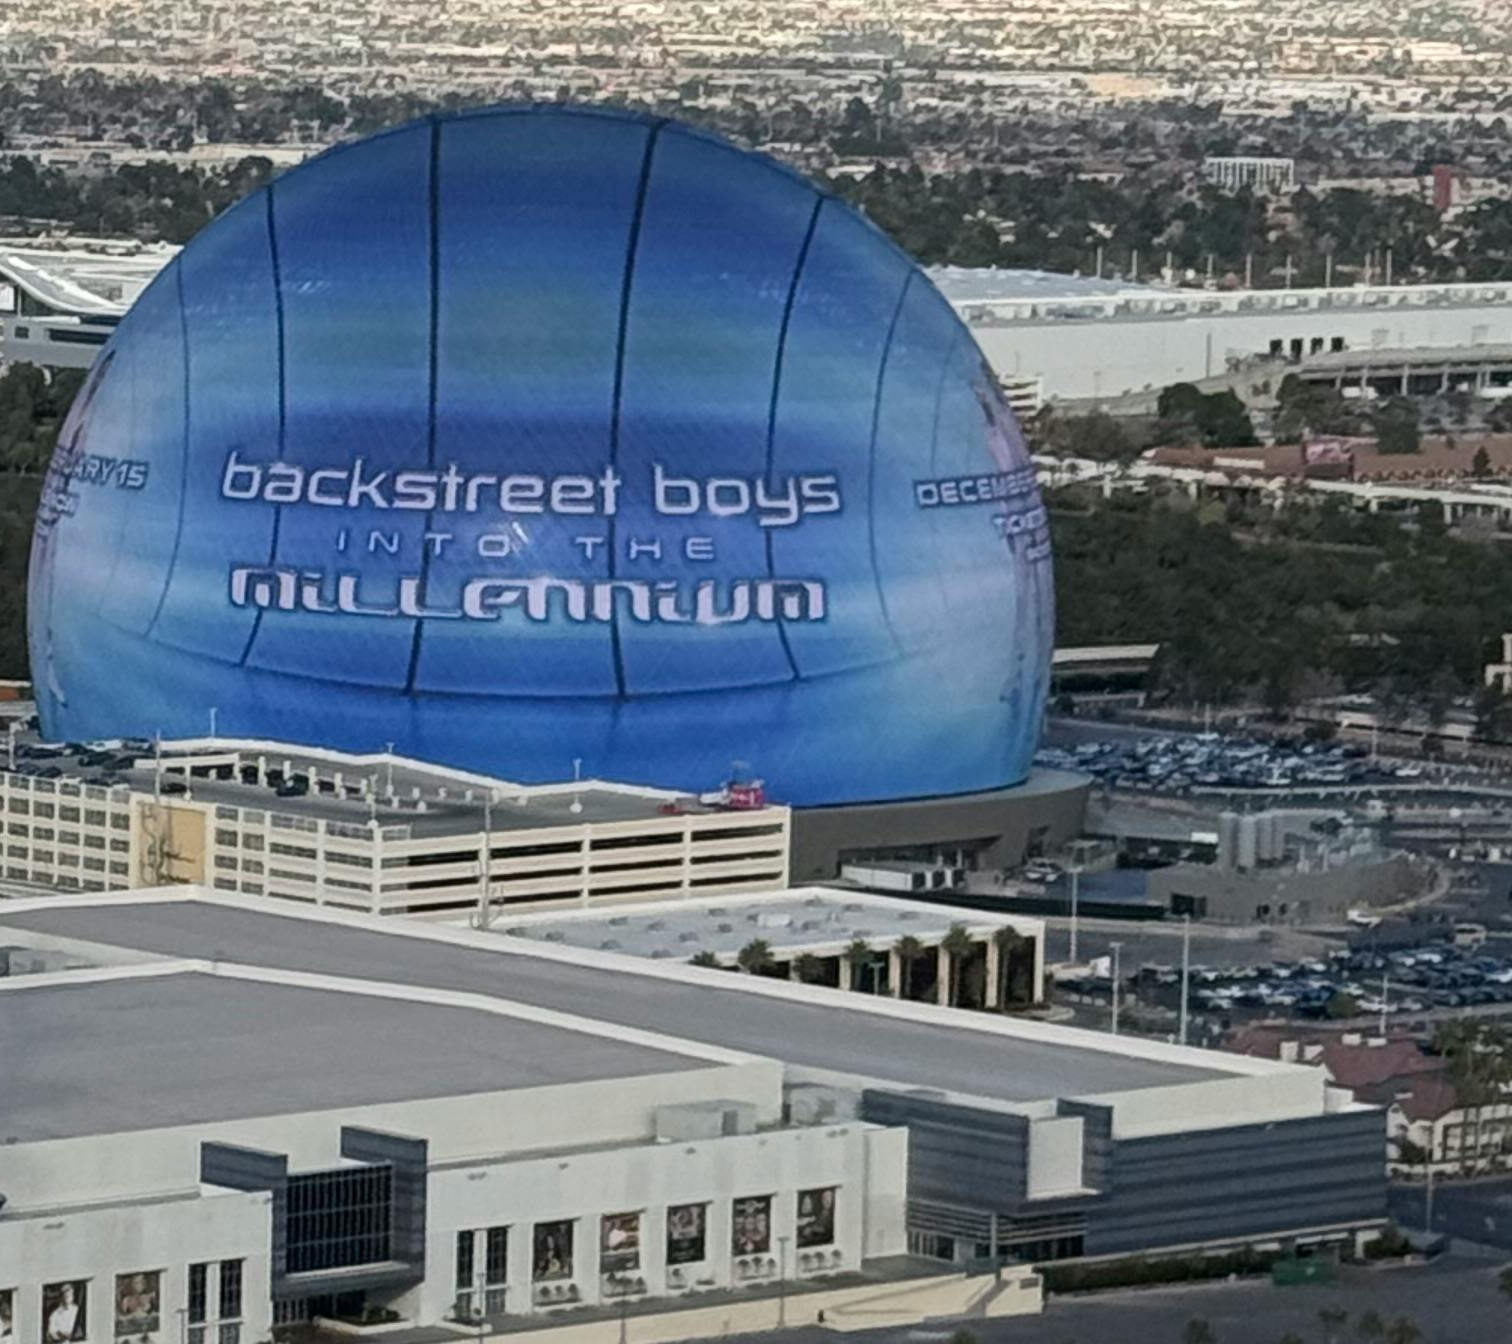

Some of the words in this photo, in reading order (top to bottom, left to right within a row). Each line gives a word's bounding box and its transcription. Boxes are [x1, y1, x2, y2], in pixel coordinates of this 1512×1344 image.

[116, 462, 146, 488] 15
[222, 451, 621, 515] backstreet
[652, 461, 840, 526] boys
[338, 529, 511, 557] INTO
[575, 537, 714, 560] THE
